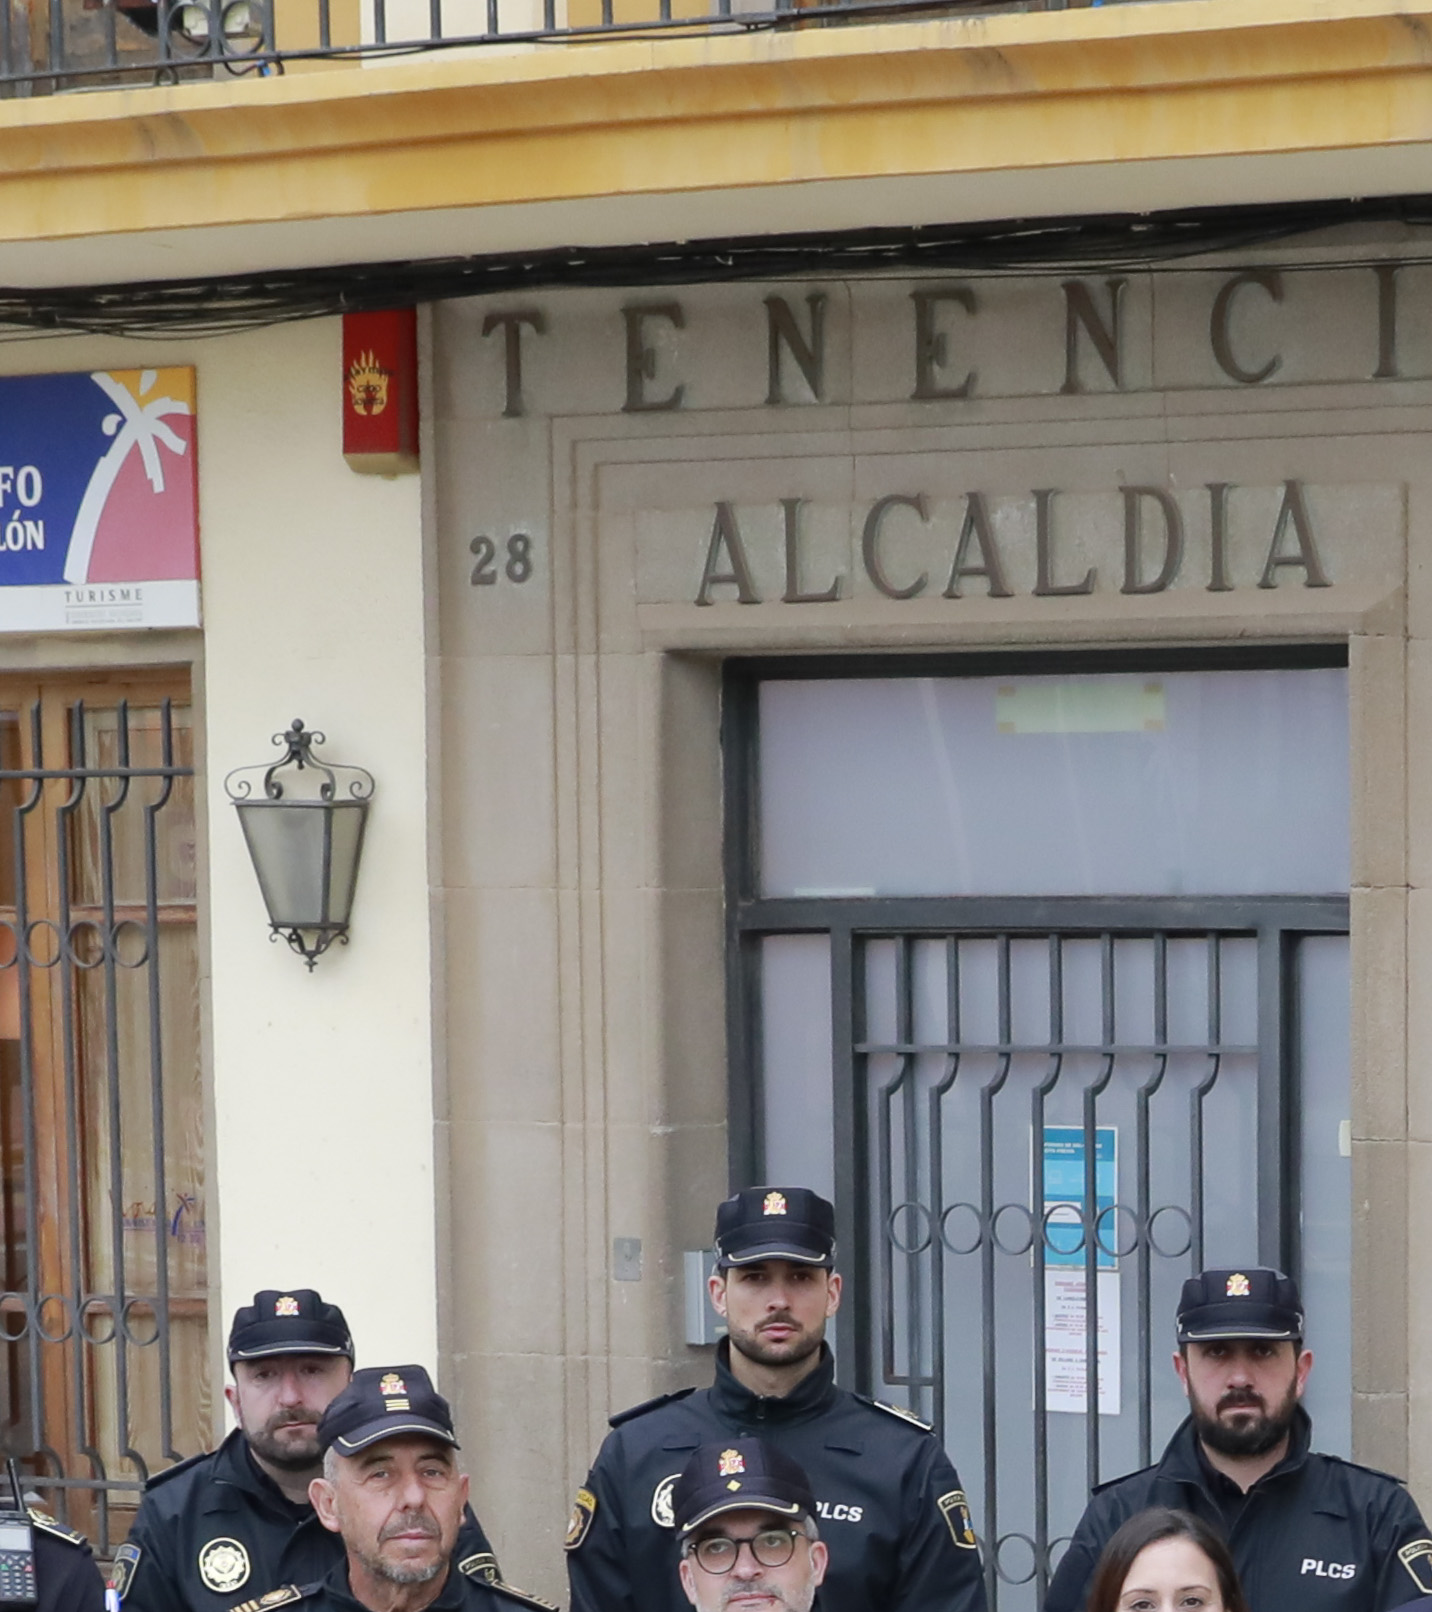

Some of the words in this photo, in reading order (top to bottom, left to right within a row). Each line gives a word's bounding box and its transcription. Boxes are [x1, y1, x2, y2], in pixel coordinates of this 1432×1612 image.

[470, 533, 533, 585] 28
[694, 479, 1333, 606] ALCALDIA
[65, 588, 143, 603] TURISME
[1301, 1559, 1356, 1579] PLCS
